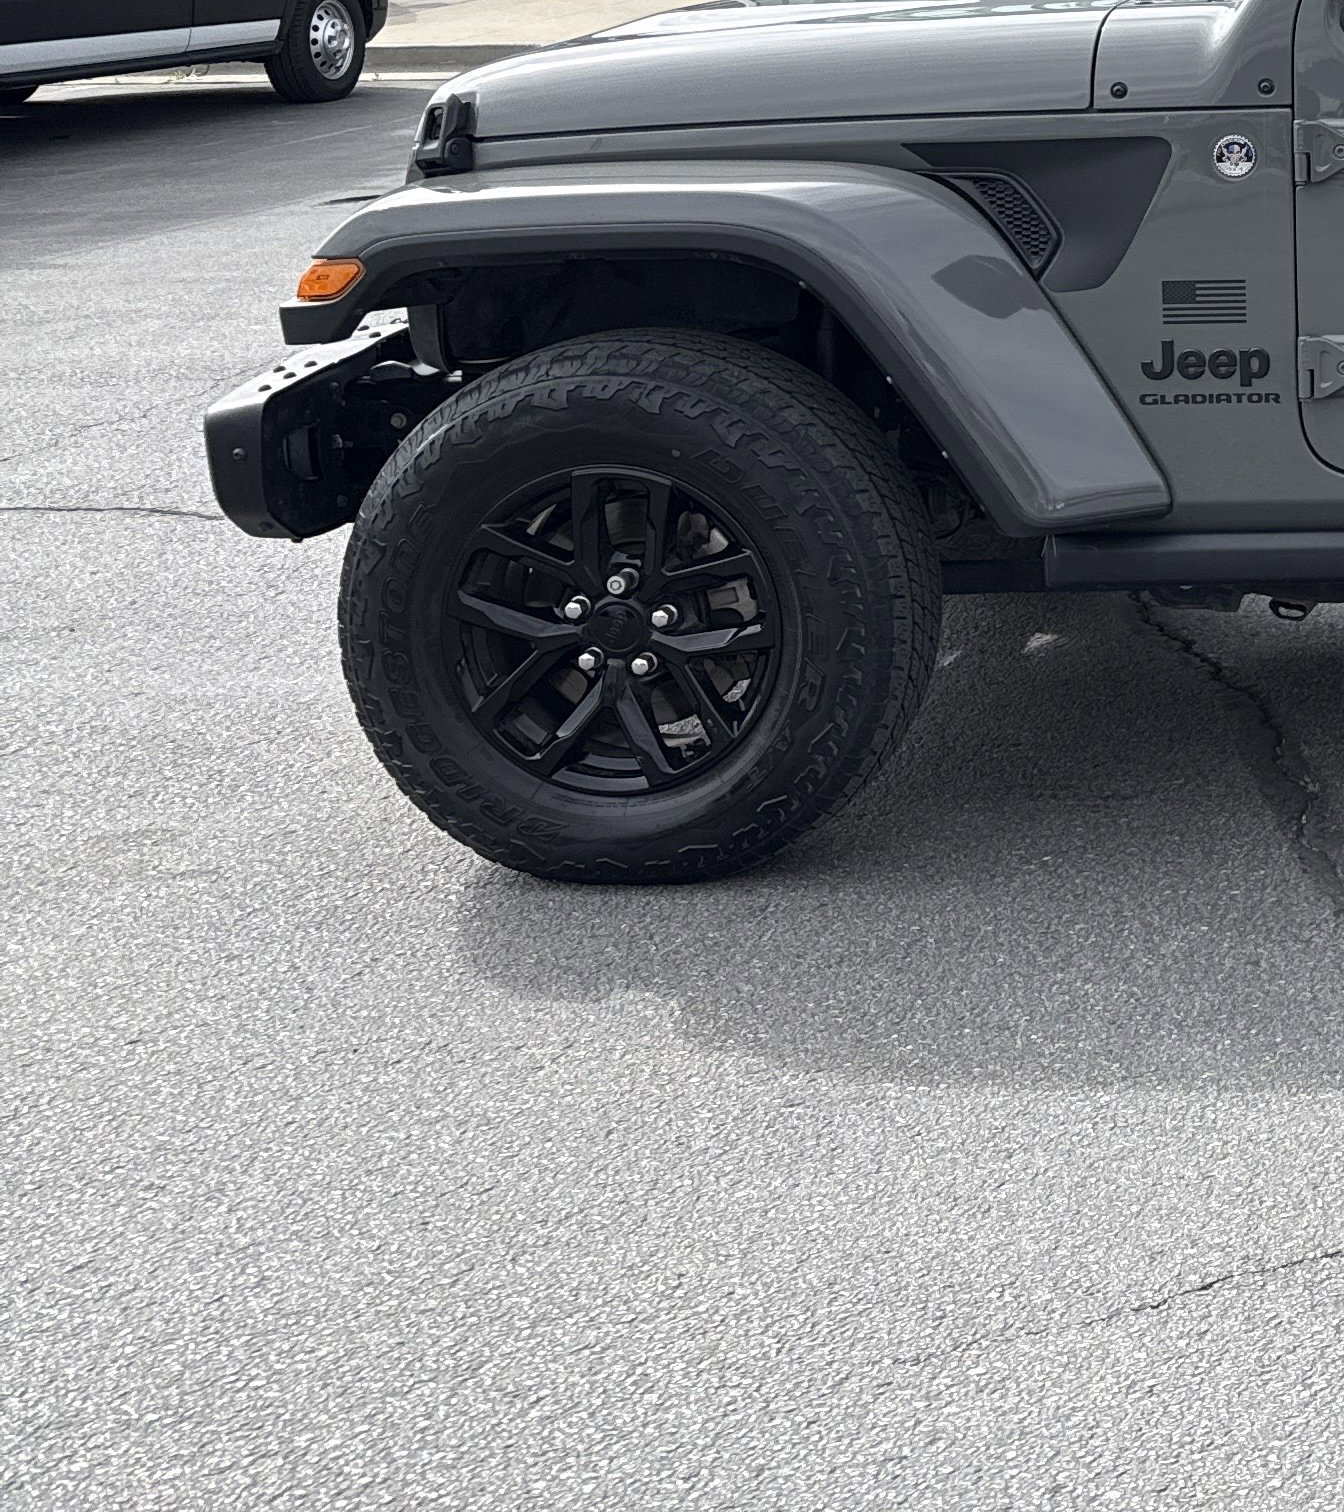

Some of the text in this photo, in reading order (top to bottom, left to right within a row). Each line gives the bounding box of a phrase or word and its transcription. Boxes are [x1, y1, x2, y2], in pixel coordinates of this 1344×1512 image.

[1141, 339, 1271, 387] Jeep
[1139, 392, 1281, 405] GLADIATOR
[373, 502, 567, 842] BRIDGESTONE
